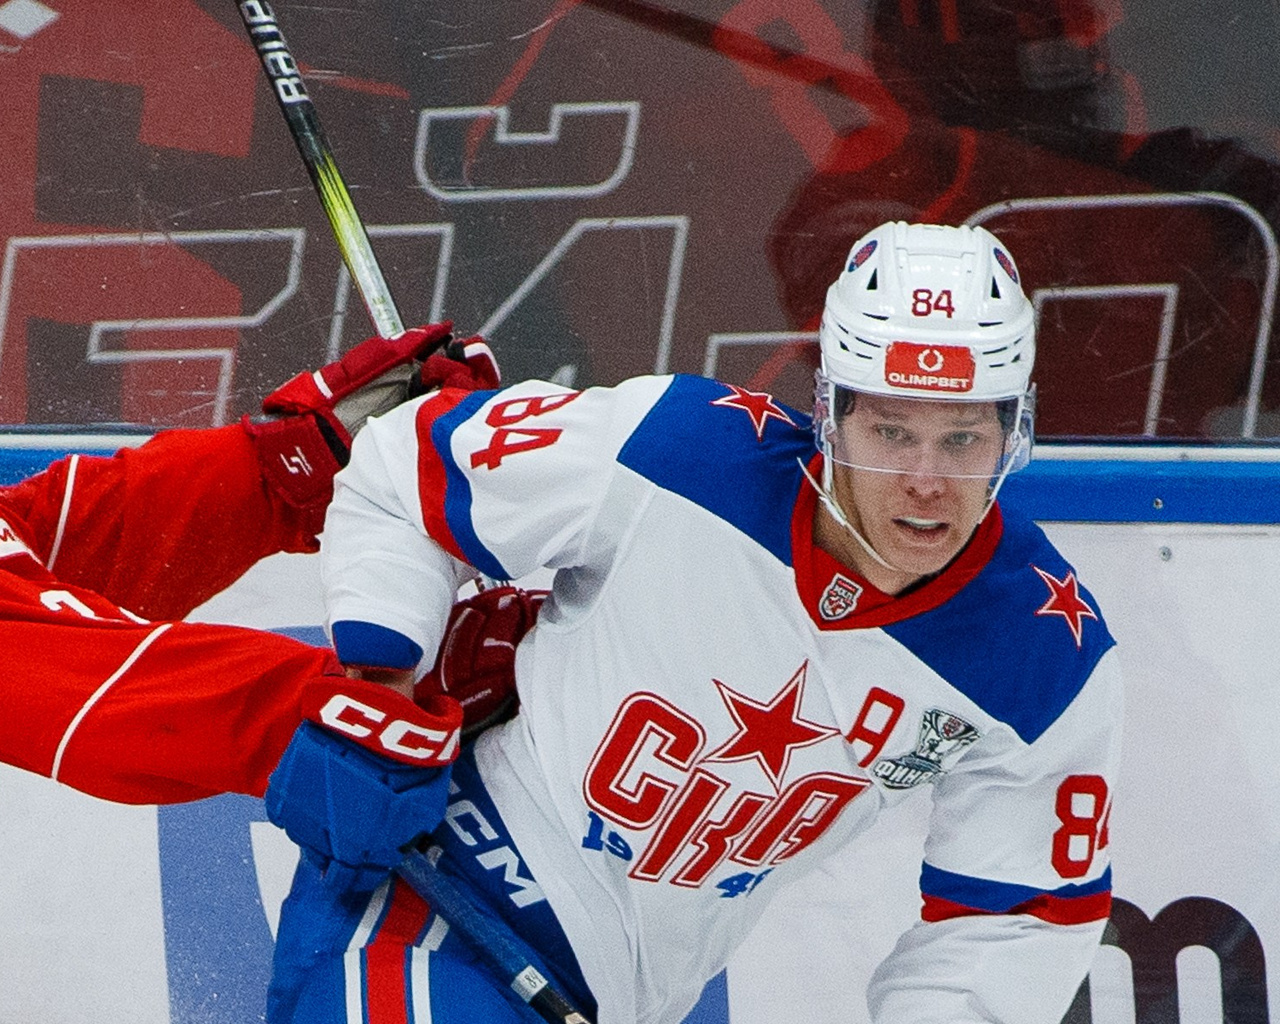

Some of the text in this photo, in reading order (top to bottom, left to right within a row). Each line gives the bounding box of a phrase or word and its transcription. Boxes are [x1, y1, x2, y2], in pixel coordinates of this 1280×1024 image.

[911, 288, 955, 318] 84
[888, 371, 970, 389] OLIMPBET
[470, 389, 585, 471] 84
[582, 690, 873, 889] СКА
[874, 760, 934, 786] ФИНА
[445, 778, 547, 909] CM
[581, 810, 633, 861] 19
[1051, 774, 1114, 878] 8
